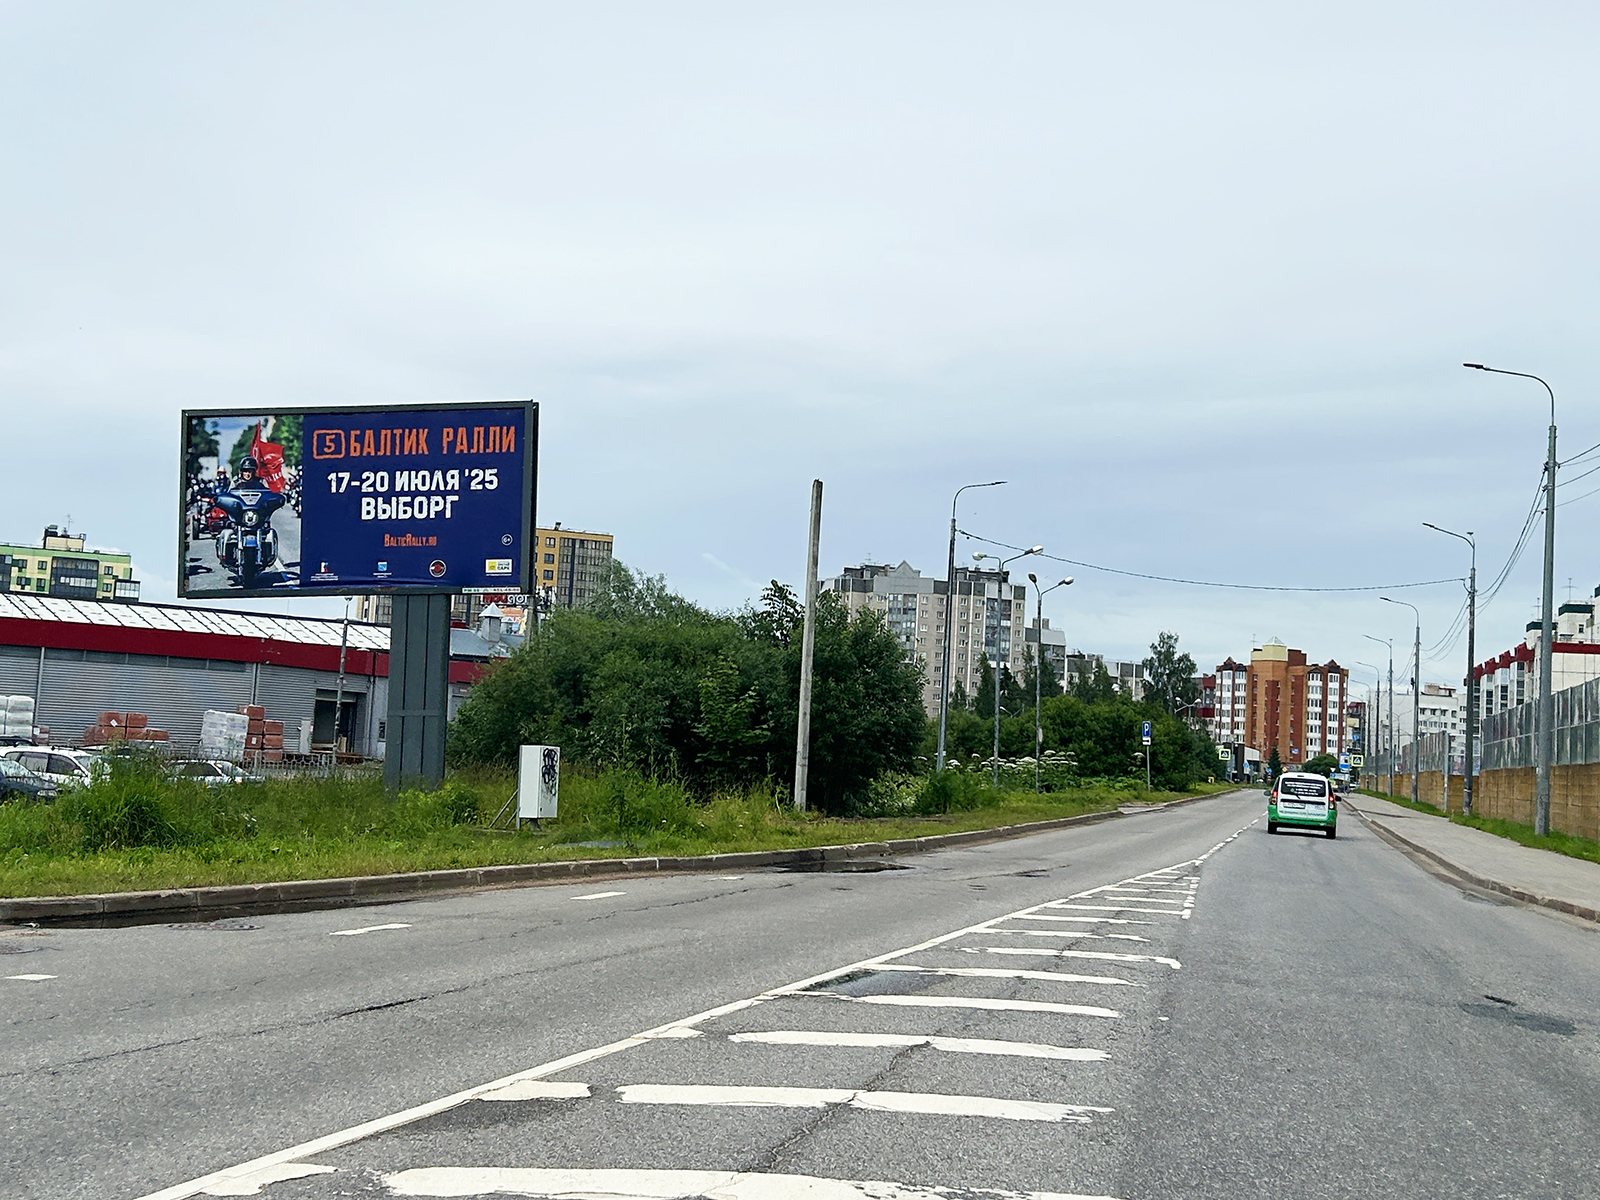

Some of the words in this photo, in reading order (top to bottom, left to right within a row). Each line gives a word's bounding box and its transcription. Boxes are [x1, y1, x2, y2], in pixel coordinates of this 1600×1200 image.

[349, 428, 429, 457] БАЛТИК
[442, 426, 516, 455] РАЛЛИ
[327, 471, 390, 494] 17-20
[395, 469, 460, 492] ИЮЛЯ
[464, 468, 499, 491] '25
[361, 495, 459, 521] ВЫБОРГ
